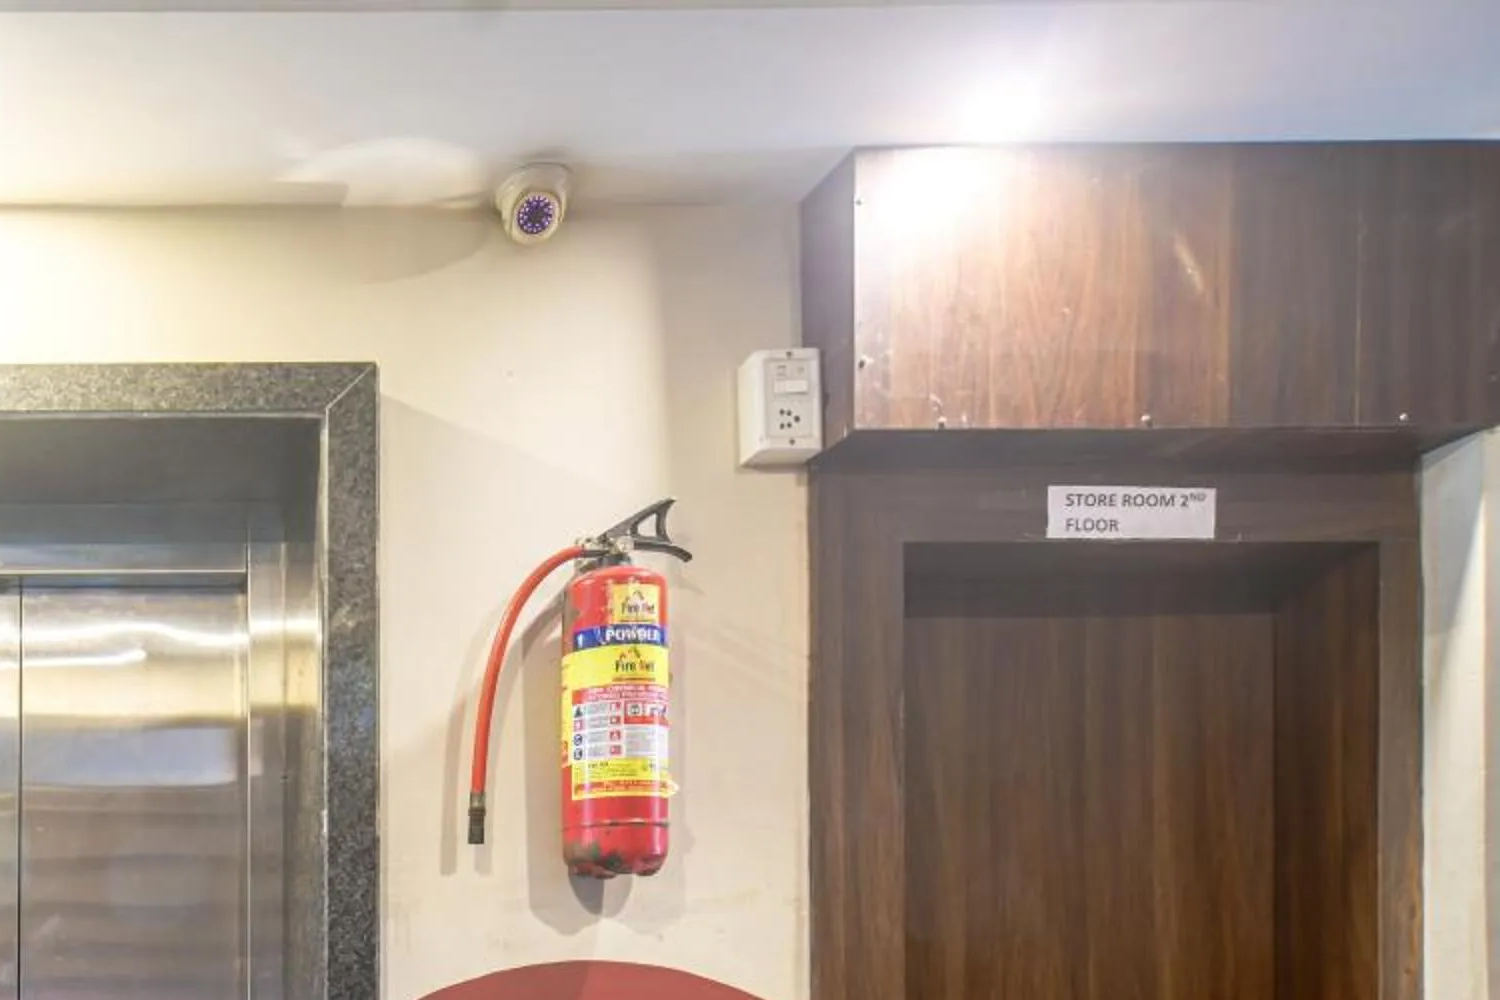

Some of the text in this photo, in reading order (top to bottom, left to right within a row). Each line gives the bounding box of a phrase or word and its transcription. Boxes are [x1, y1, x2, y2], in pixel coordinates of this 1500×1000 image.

[1065, 493, 1117, 508] STORE
[1122, 493, 1175, 508] ROOM
[1065, 518, 1120, 532] FLOOR
